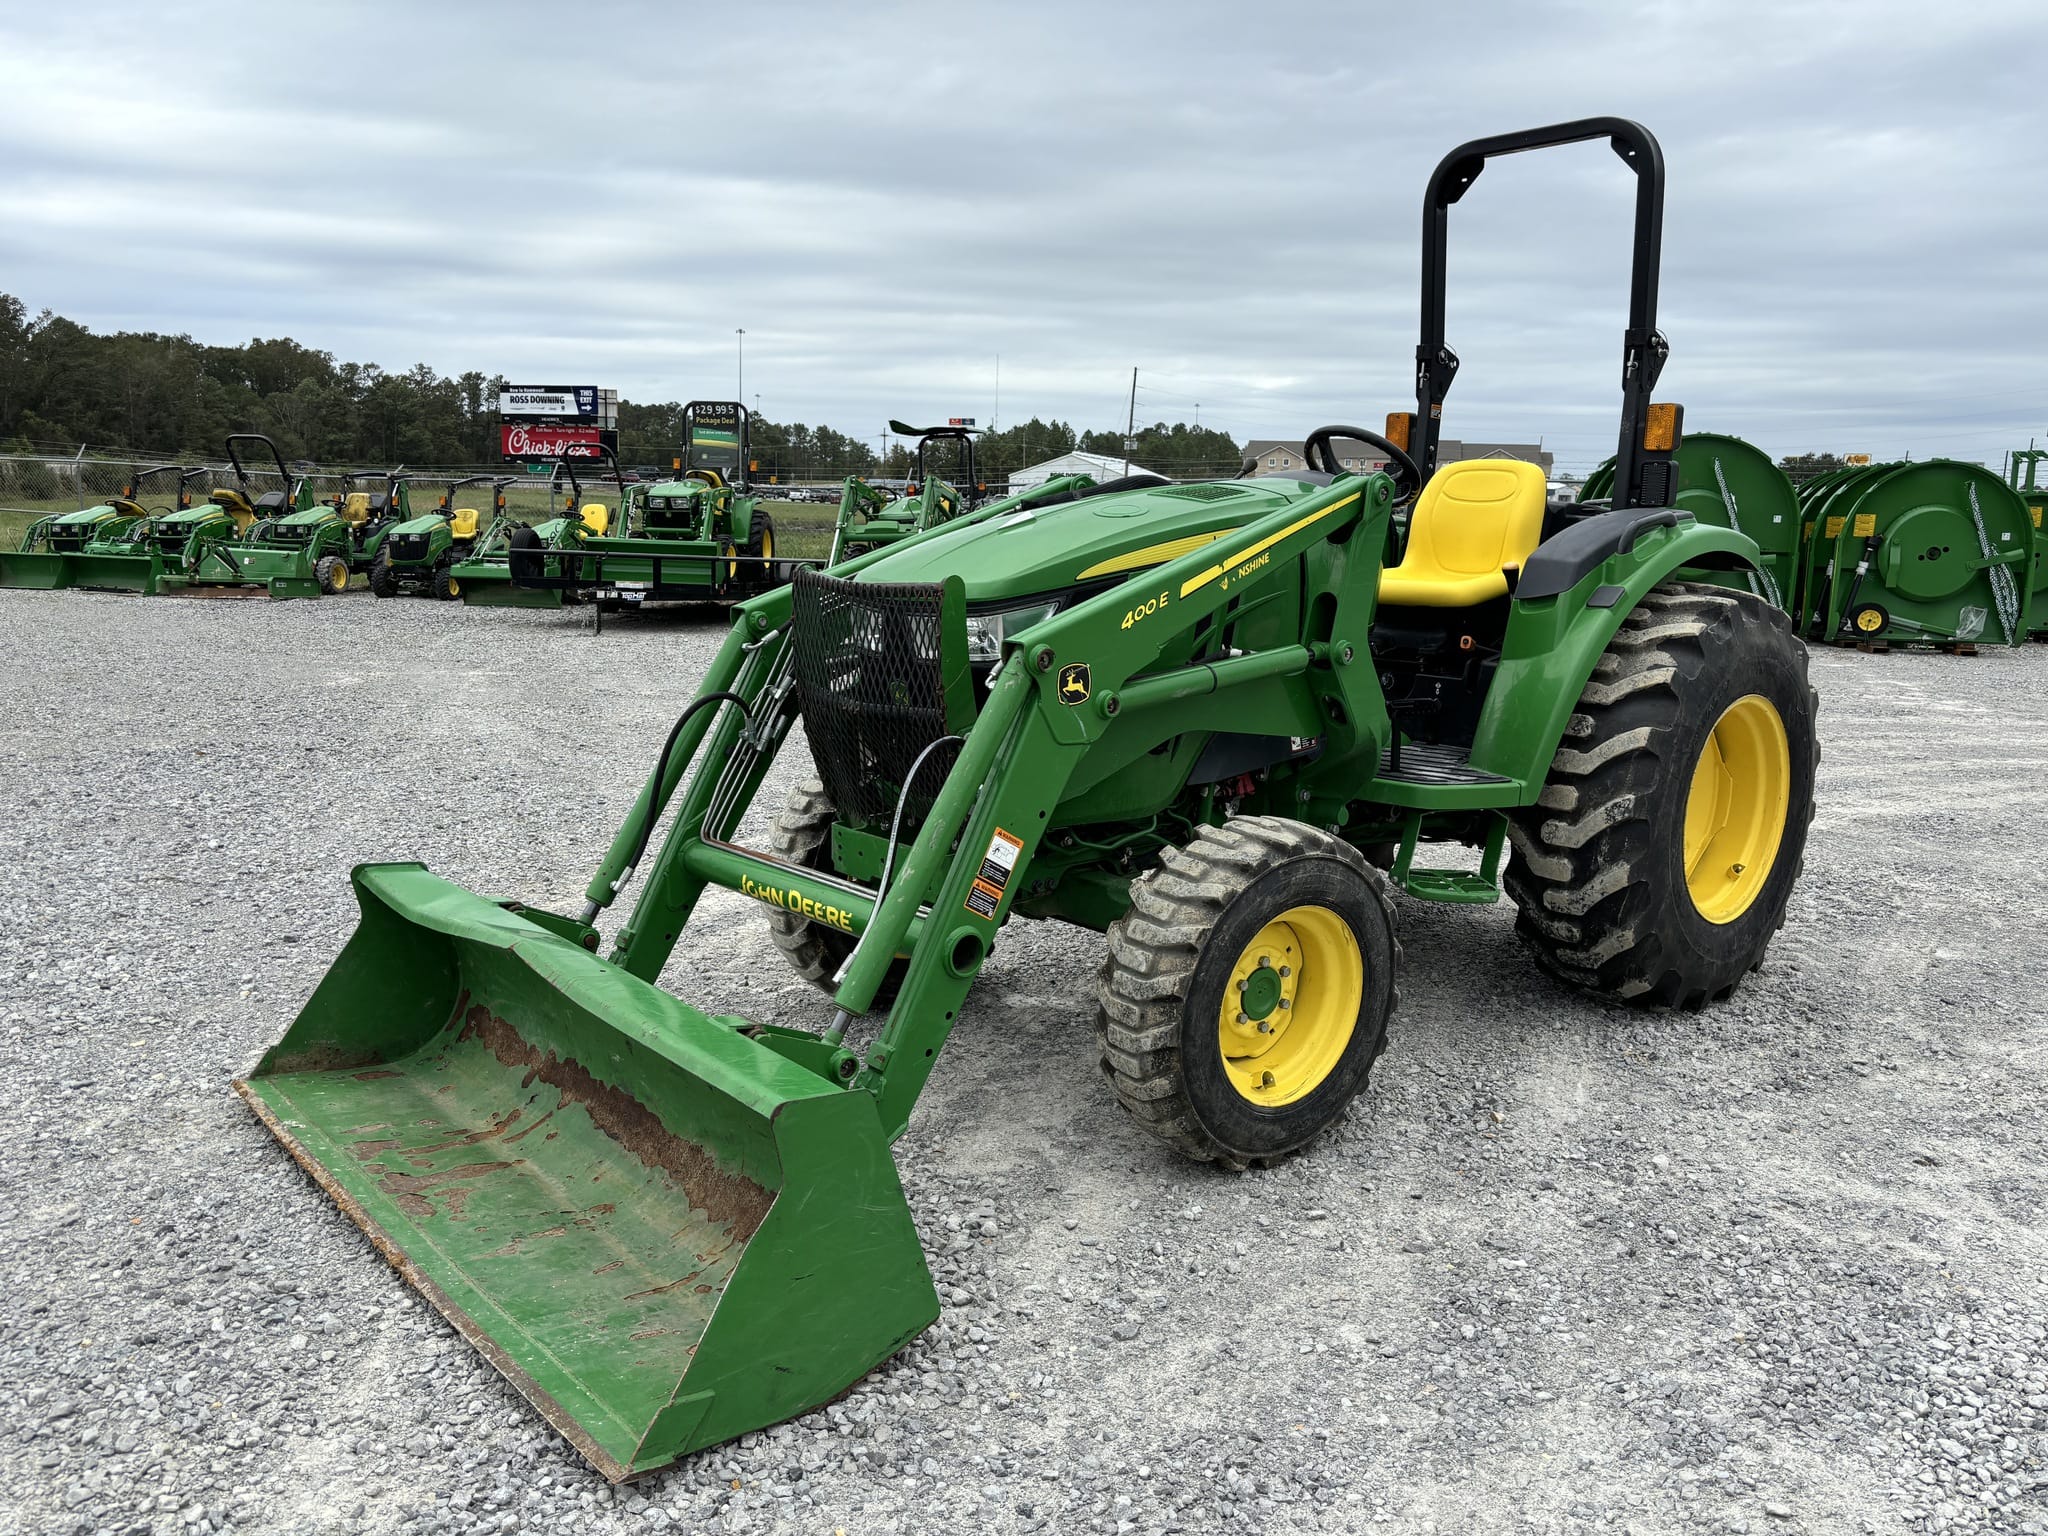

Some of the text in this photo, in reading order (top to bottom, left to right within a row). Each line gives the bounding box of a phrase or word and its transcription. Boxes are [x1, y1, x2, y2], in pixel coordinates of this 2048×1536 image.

[579, 389, 593, 397] THIS
[509, 395, 565, 405] ROSS DOWNING
[579, 396, 592, 404] EXIT
[695, 416, 736, 426] Package Deal
[738, 873, 854, 932] JOHN DEERE
